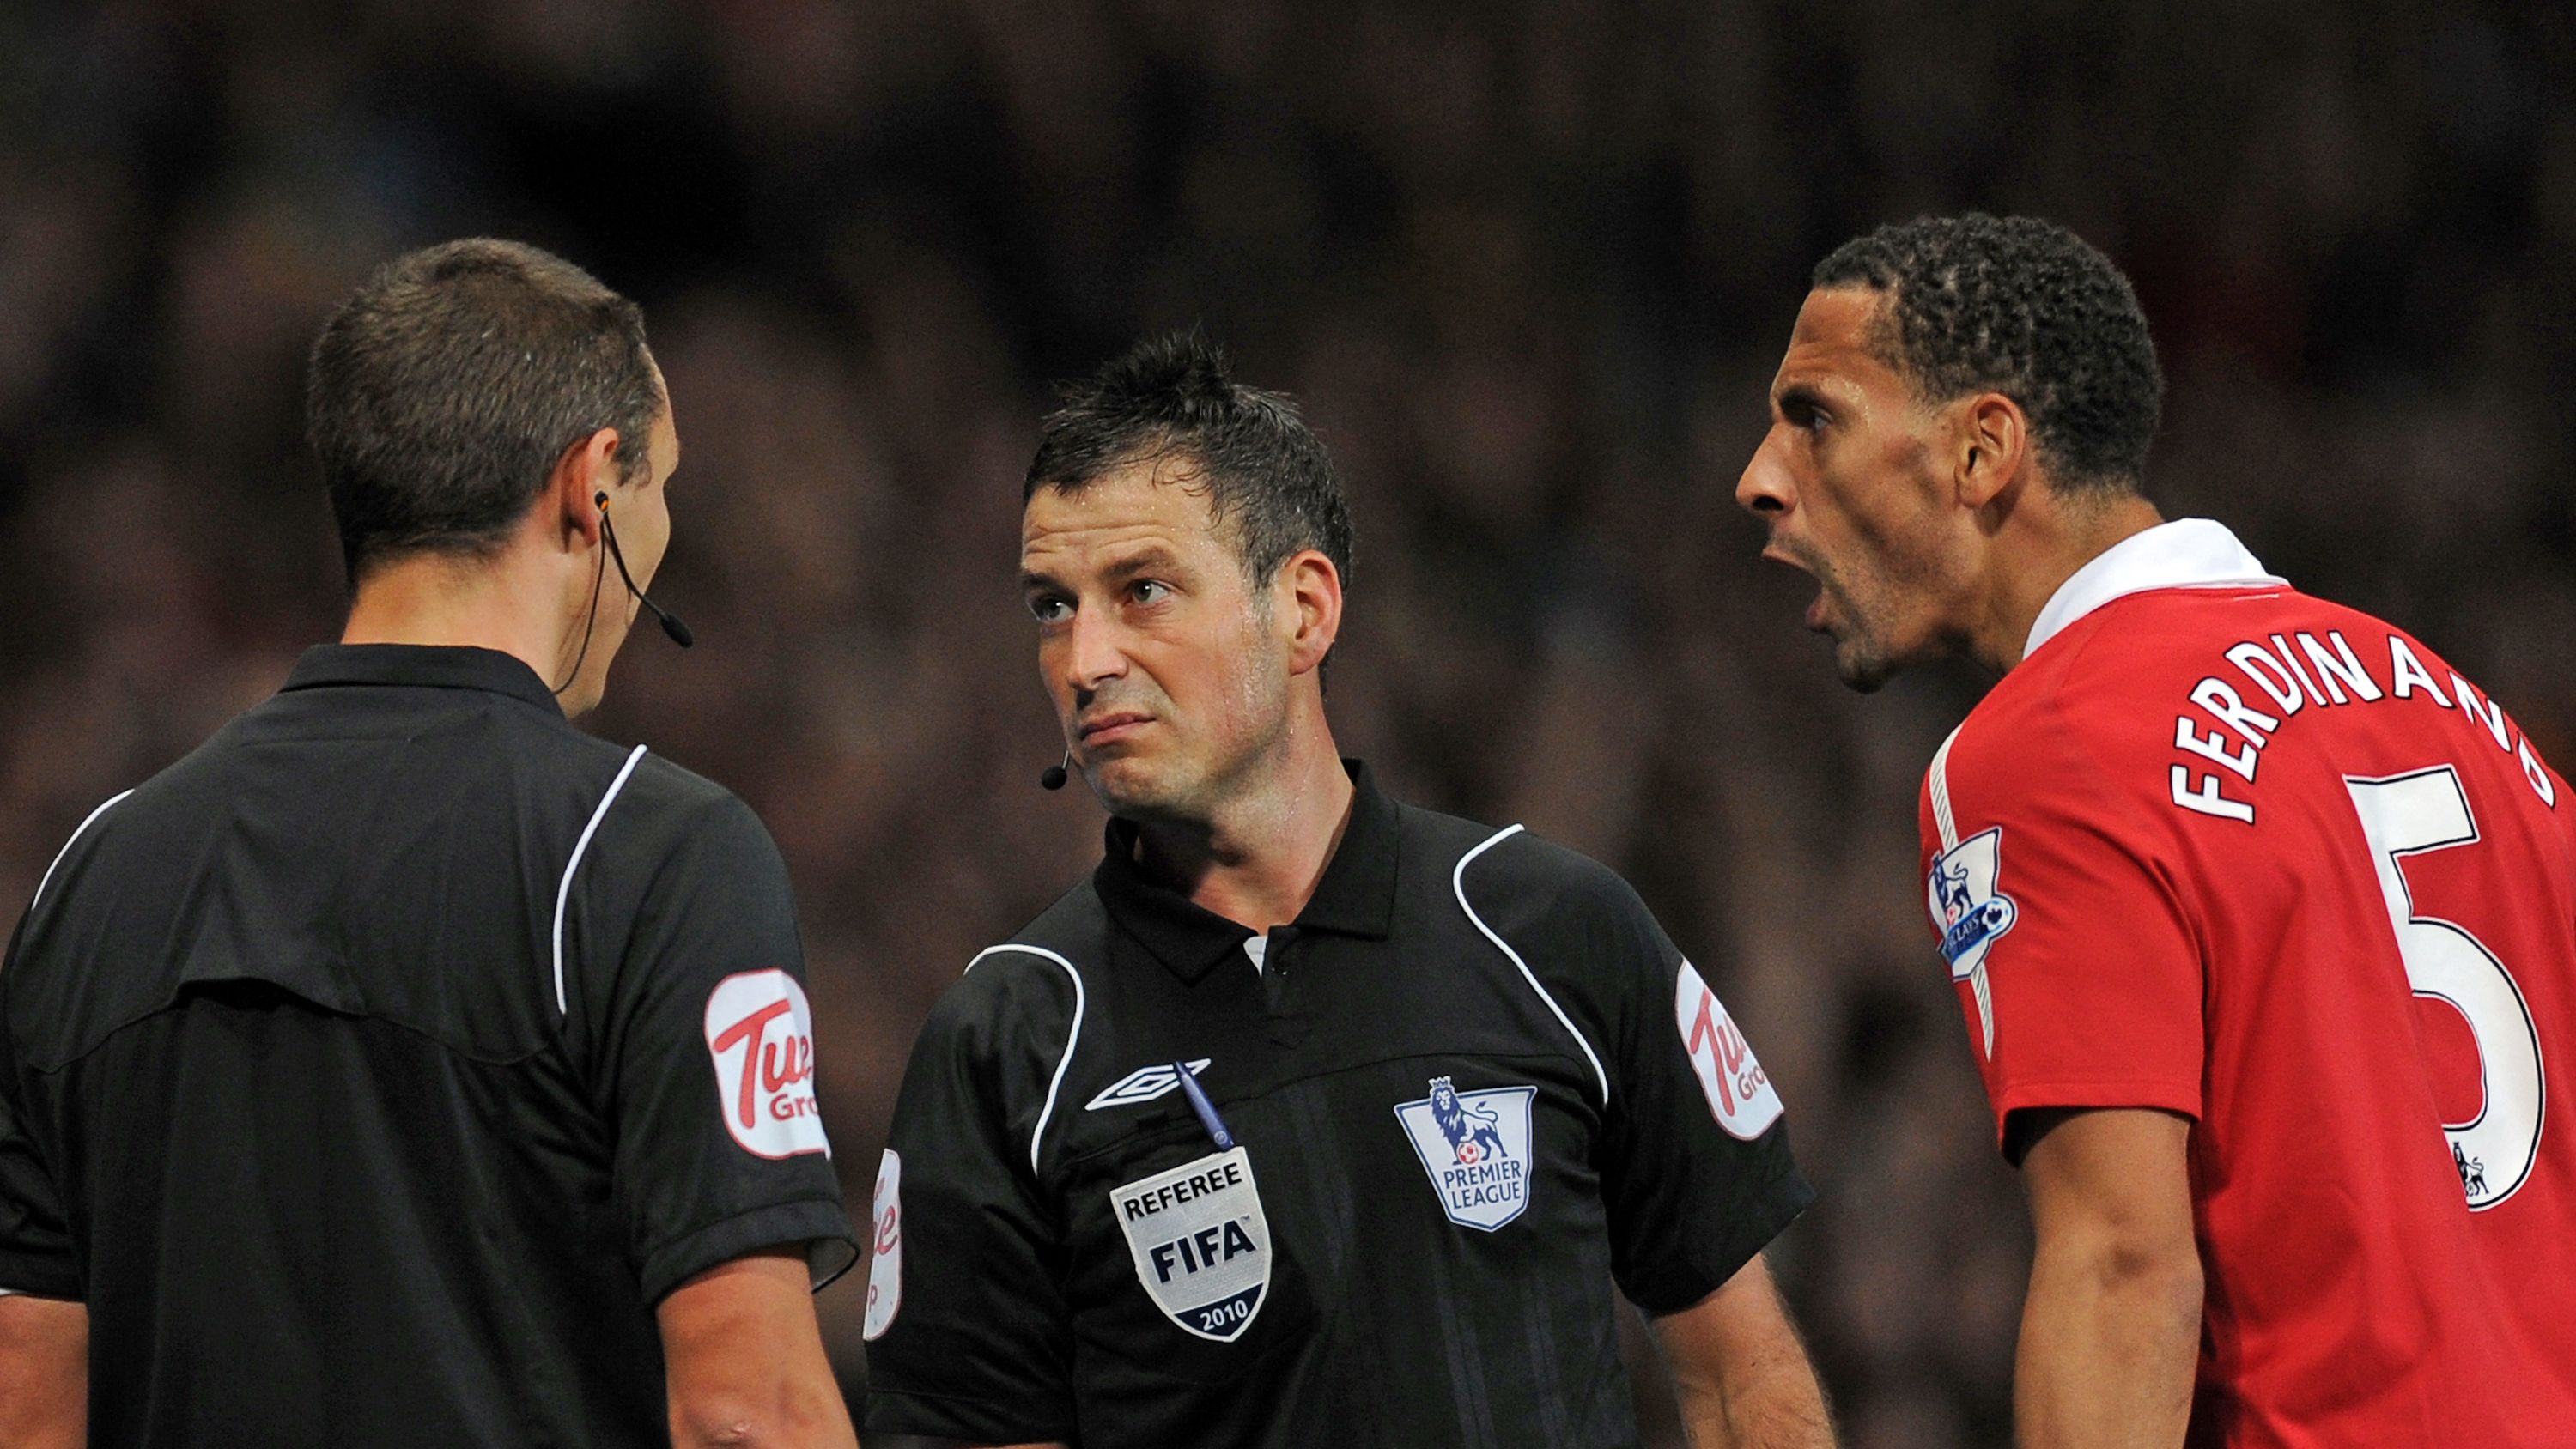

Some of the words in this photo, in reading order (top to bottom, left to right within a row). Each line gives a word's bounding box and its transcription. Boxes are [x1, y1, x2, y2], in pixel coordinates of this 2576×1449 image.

[2170, 630, 2556, 824] FERDINAND
[2342, 763, 2547, 1213] 5
[1737, 1064, 1765, 1100] Gro
[769, 1093, 819, 1121] Gro
[1123, 1161, 1242, 1222] REFEREE
[1443, 1160, 1522, 1190] PREMIER
[1451, 1180, 1521, 1210] LEAGUE
[1150, 1218, 1257, 1284] FIFA
[1199, 1299, 1249, 1331] 2010
